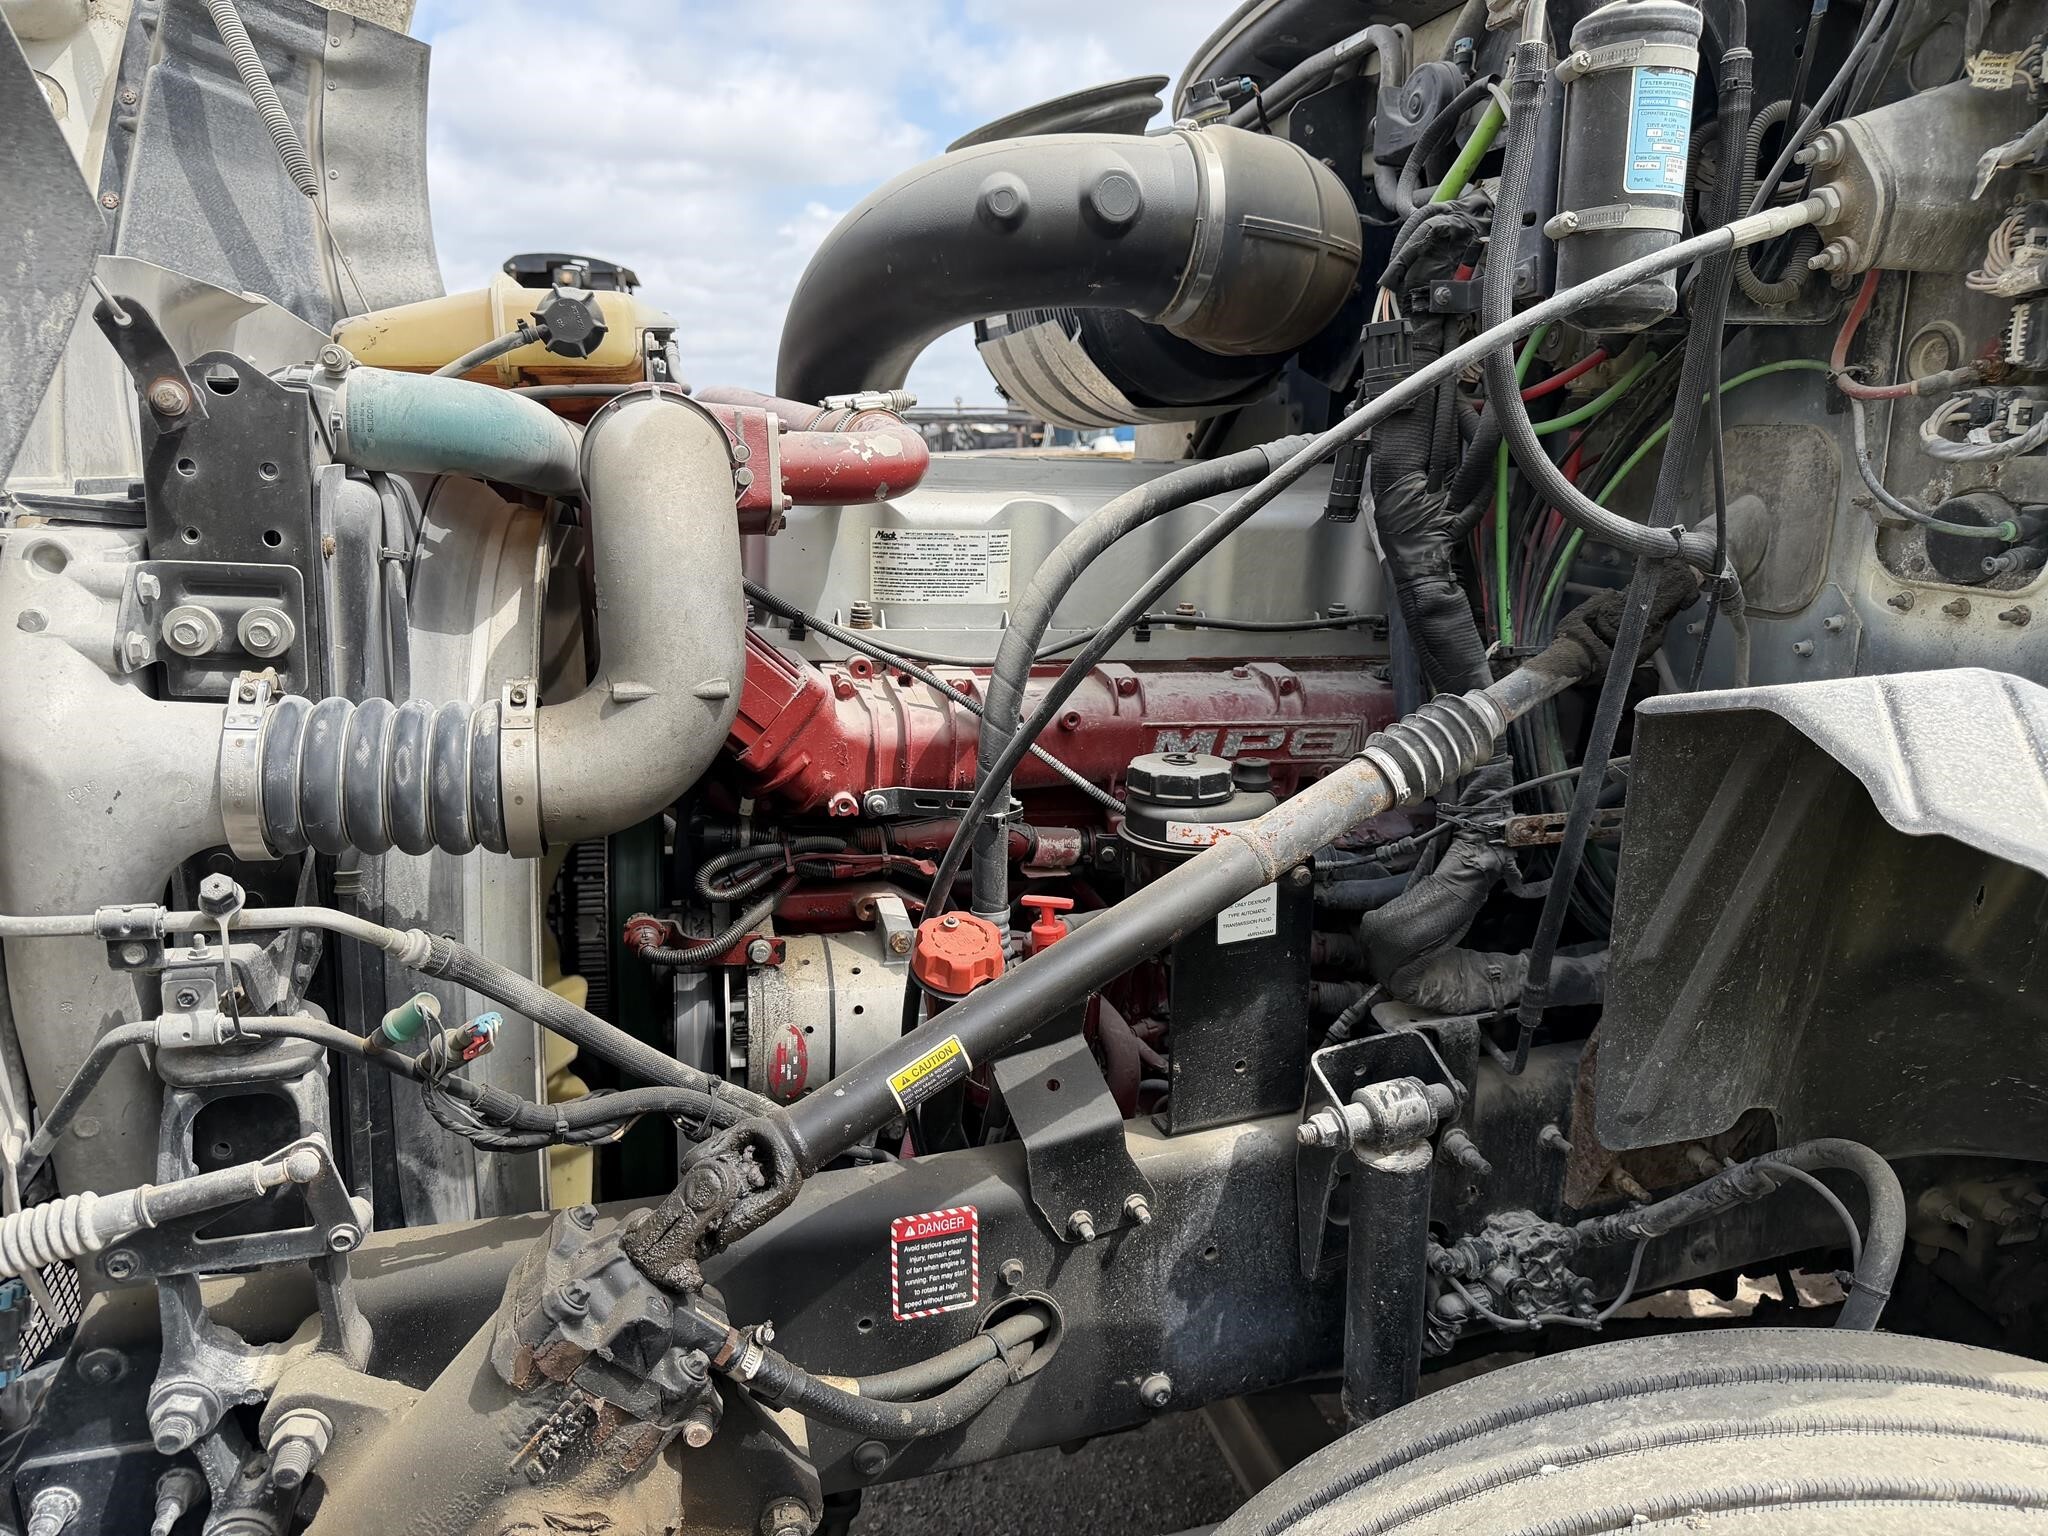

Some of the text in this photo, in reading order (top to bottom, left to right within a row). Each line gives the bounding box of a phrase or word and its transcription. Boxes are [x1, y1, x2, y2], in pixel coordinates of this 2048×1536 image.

[1241, 908, 1267, 916] AUTOMATIC
[1223, 920, 1257, 928] TRANSMISSION
[912, 1045, 953, 1077] CAUTION
[918, 1217, 965, 1235] DANGER
[904, 1236, 967, 1253] Avoid serious personal
[927, 1252, 947, 1260] remain
[948, 1248, 962, 1256] clear
[913, 1266, 922, 1274] fan
[923, 1264, 939, 1272] when
[940, 1260, 959, 1270] engine
[941, 1271, 953, 1280] may
[954, 1269, 967, 1277] start
[921, 1286, 938, 1294] rotate
[946, 1282, 958, 1291] high
[904, 1293, 968, 1309] speed without warning.
